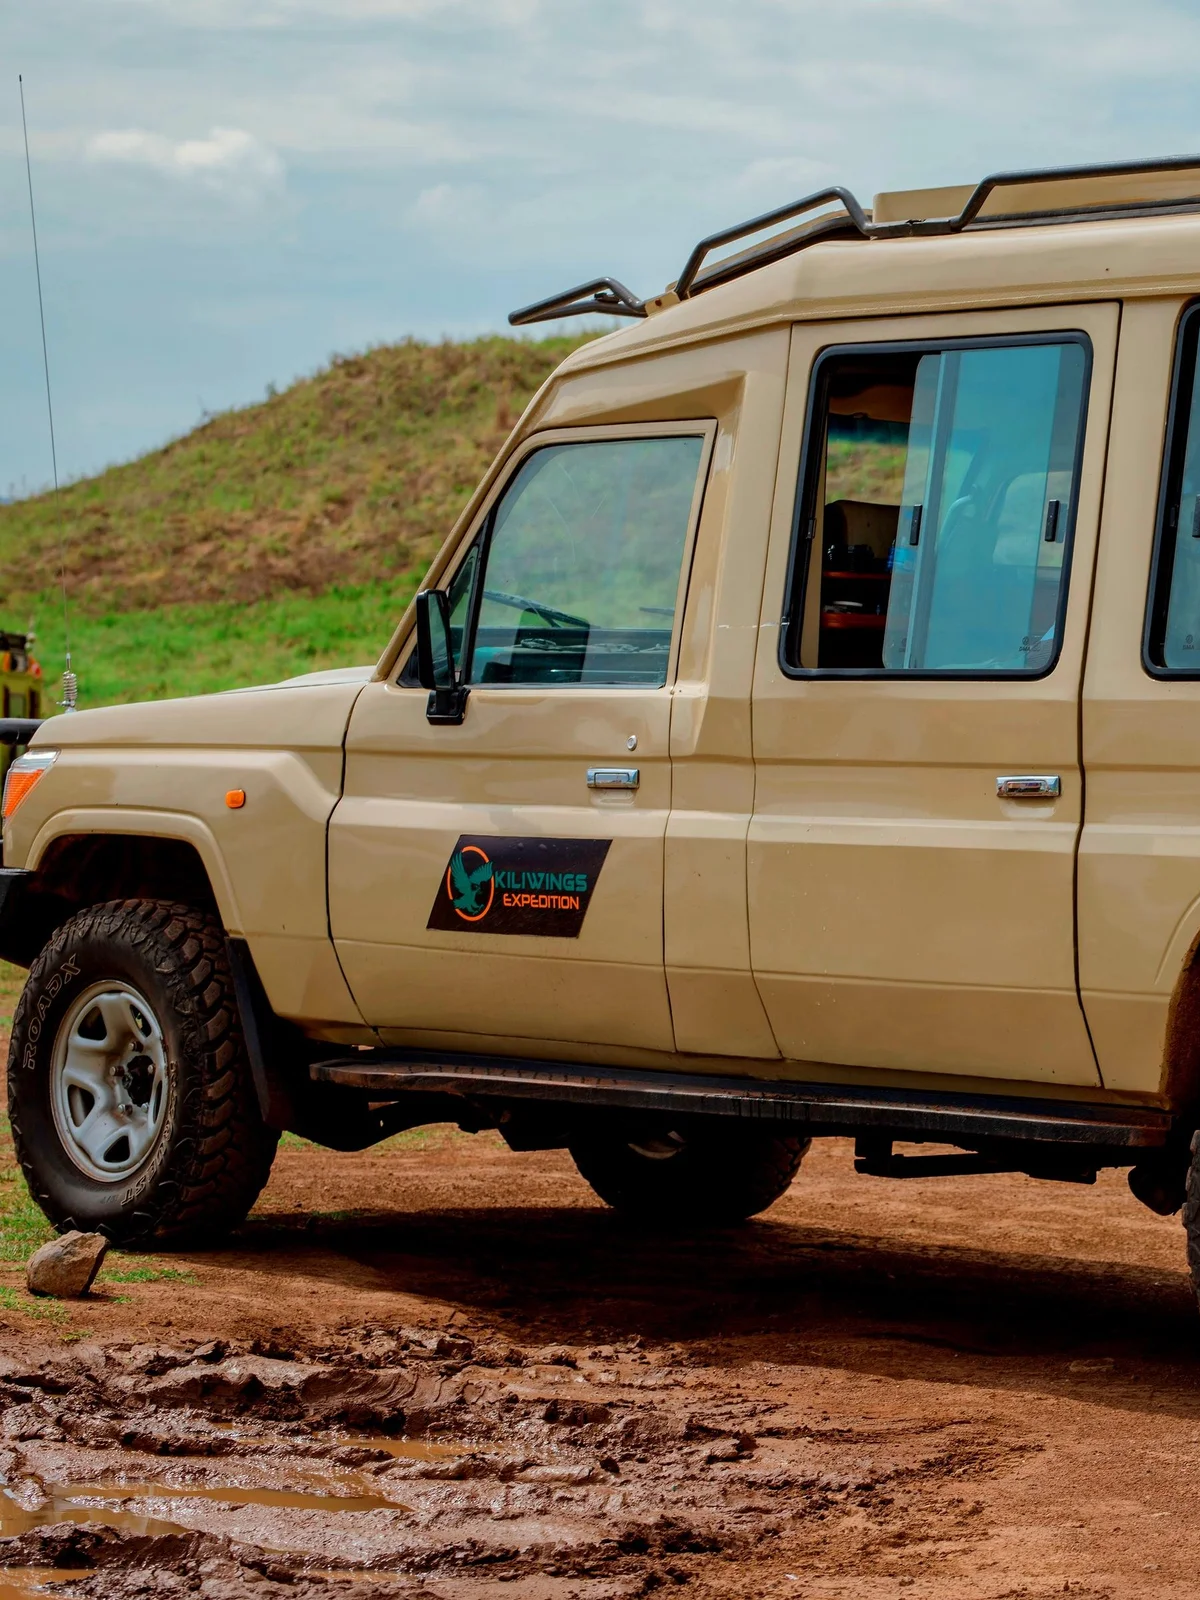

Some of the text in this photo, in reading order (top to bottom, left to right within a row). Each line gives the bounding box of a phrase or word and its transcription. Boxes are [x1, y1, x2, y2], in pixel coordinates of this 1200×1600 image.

[494, 871, 588, 892] KILIWINGS
[503, 893, 580, 910] EXPEDITION
[22, 952, 82, 1070] ROADX
